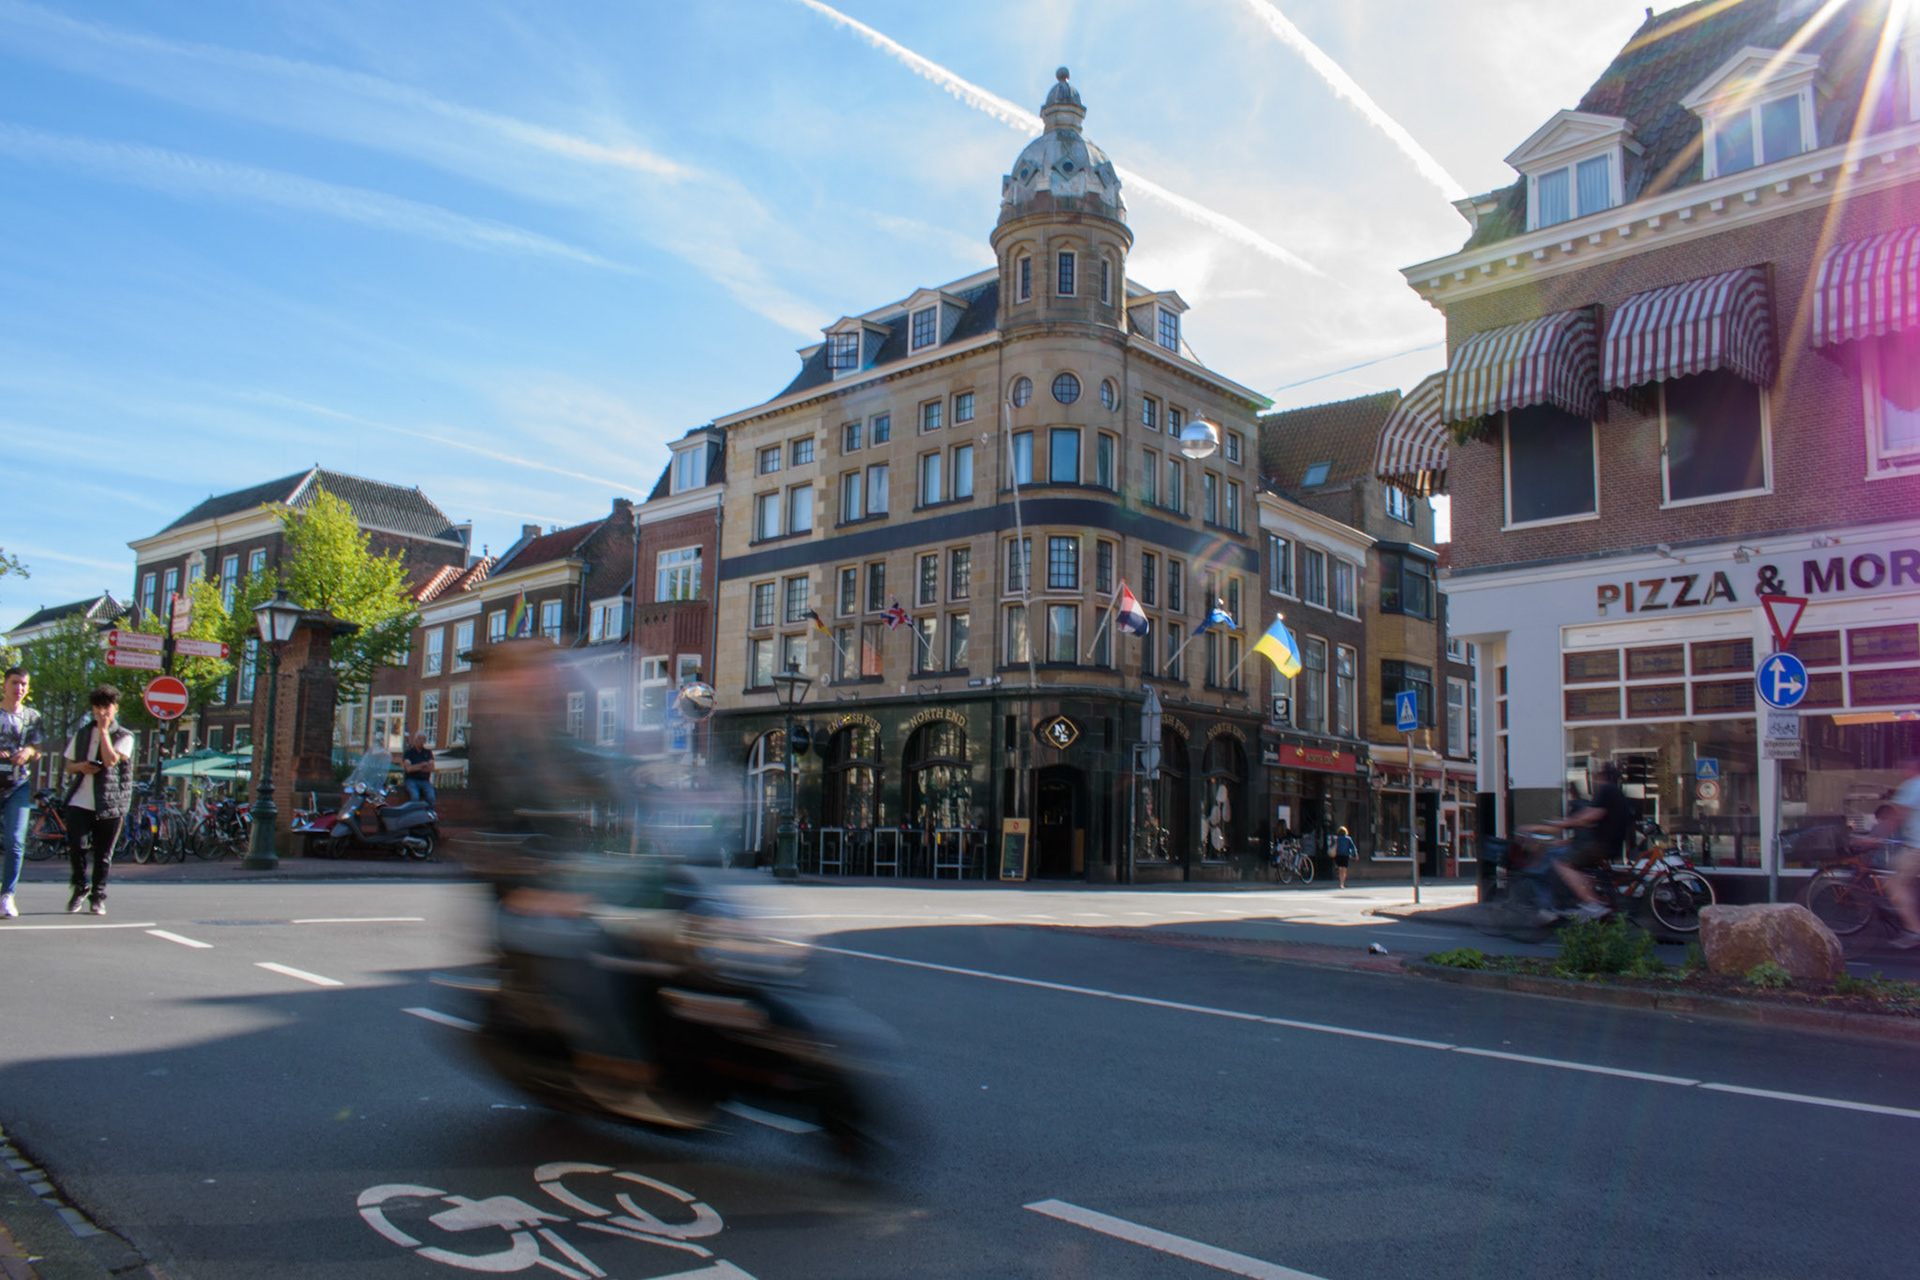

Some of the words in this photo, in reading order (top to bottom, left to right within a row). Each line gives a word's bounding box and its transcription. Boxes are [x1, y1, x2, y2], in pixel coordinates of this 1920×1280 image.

[1597, 571, 1738, 616] PIZZA
[1755, 565, 1787, 597] &
[864, 714, 882, 734] PUB
[910, 707, 944, 728] NORTH
[945, 709, 967, 728] END
[1206, 722, 1232, 741] NORTH
[1232, 723, 1247, 744] END
